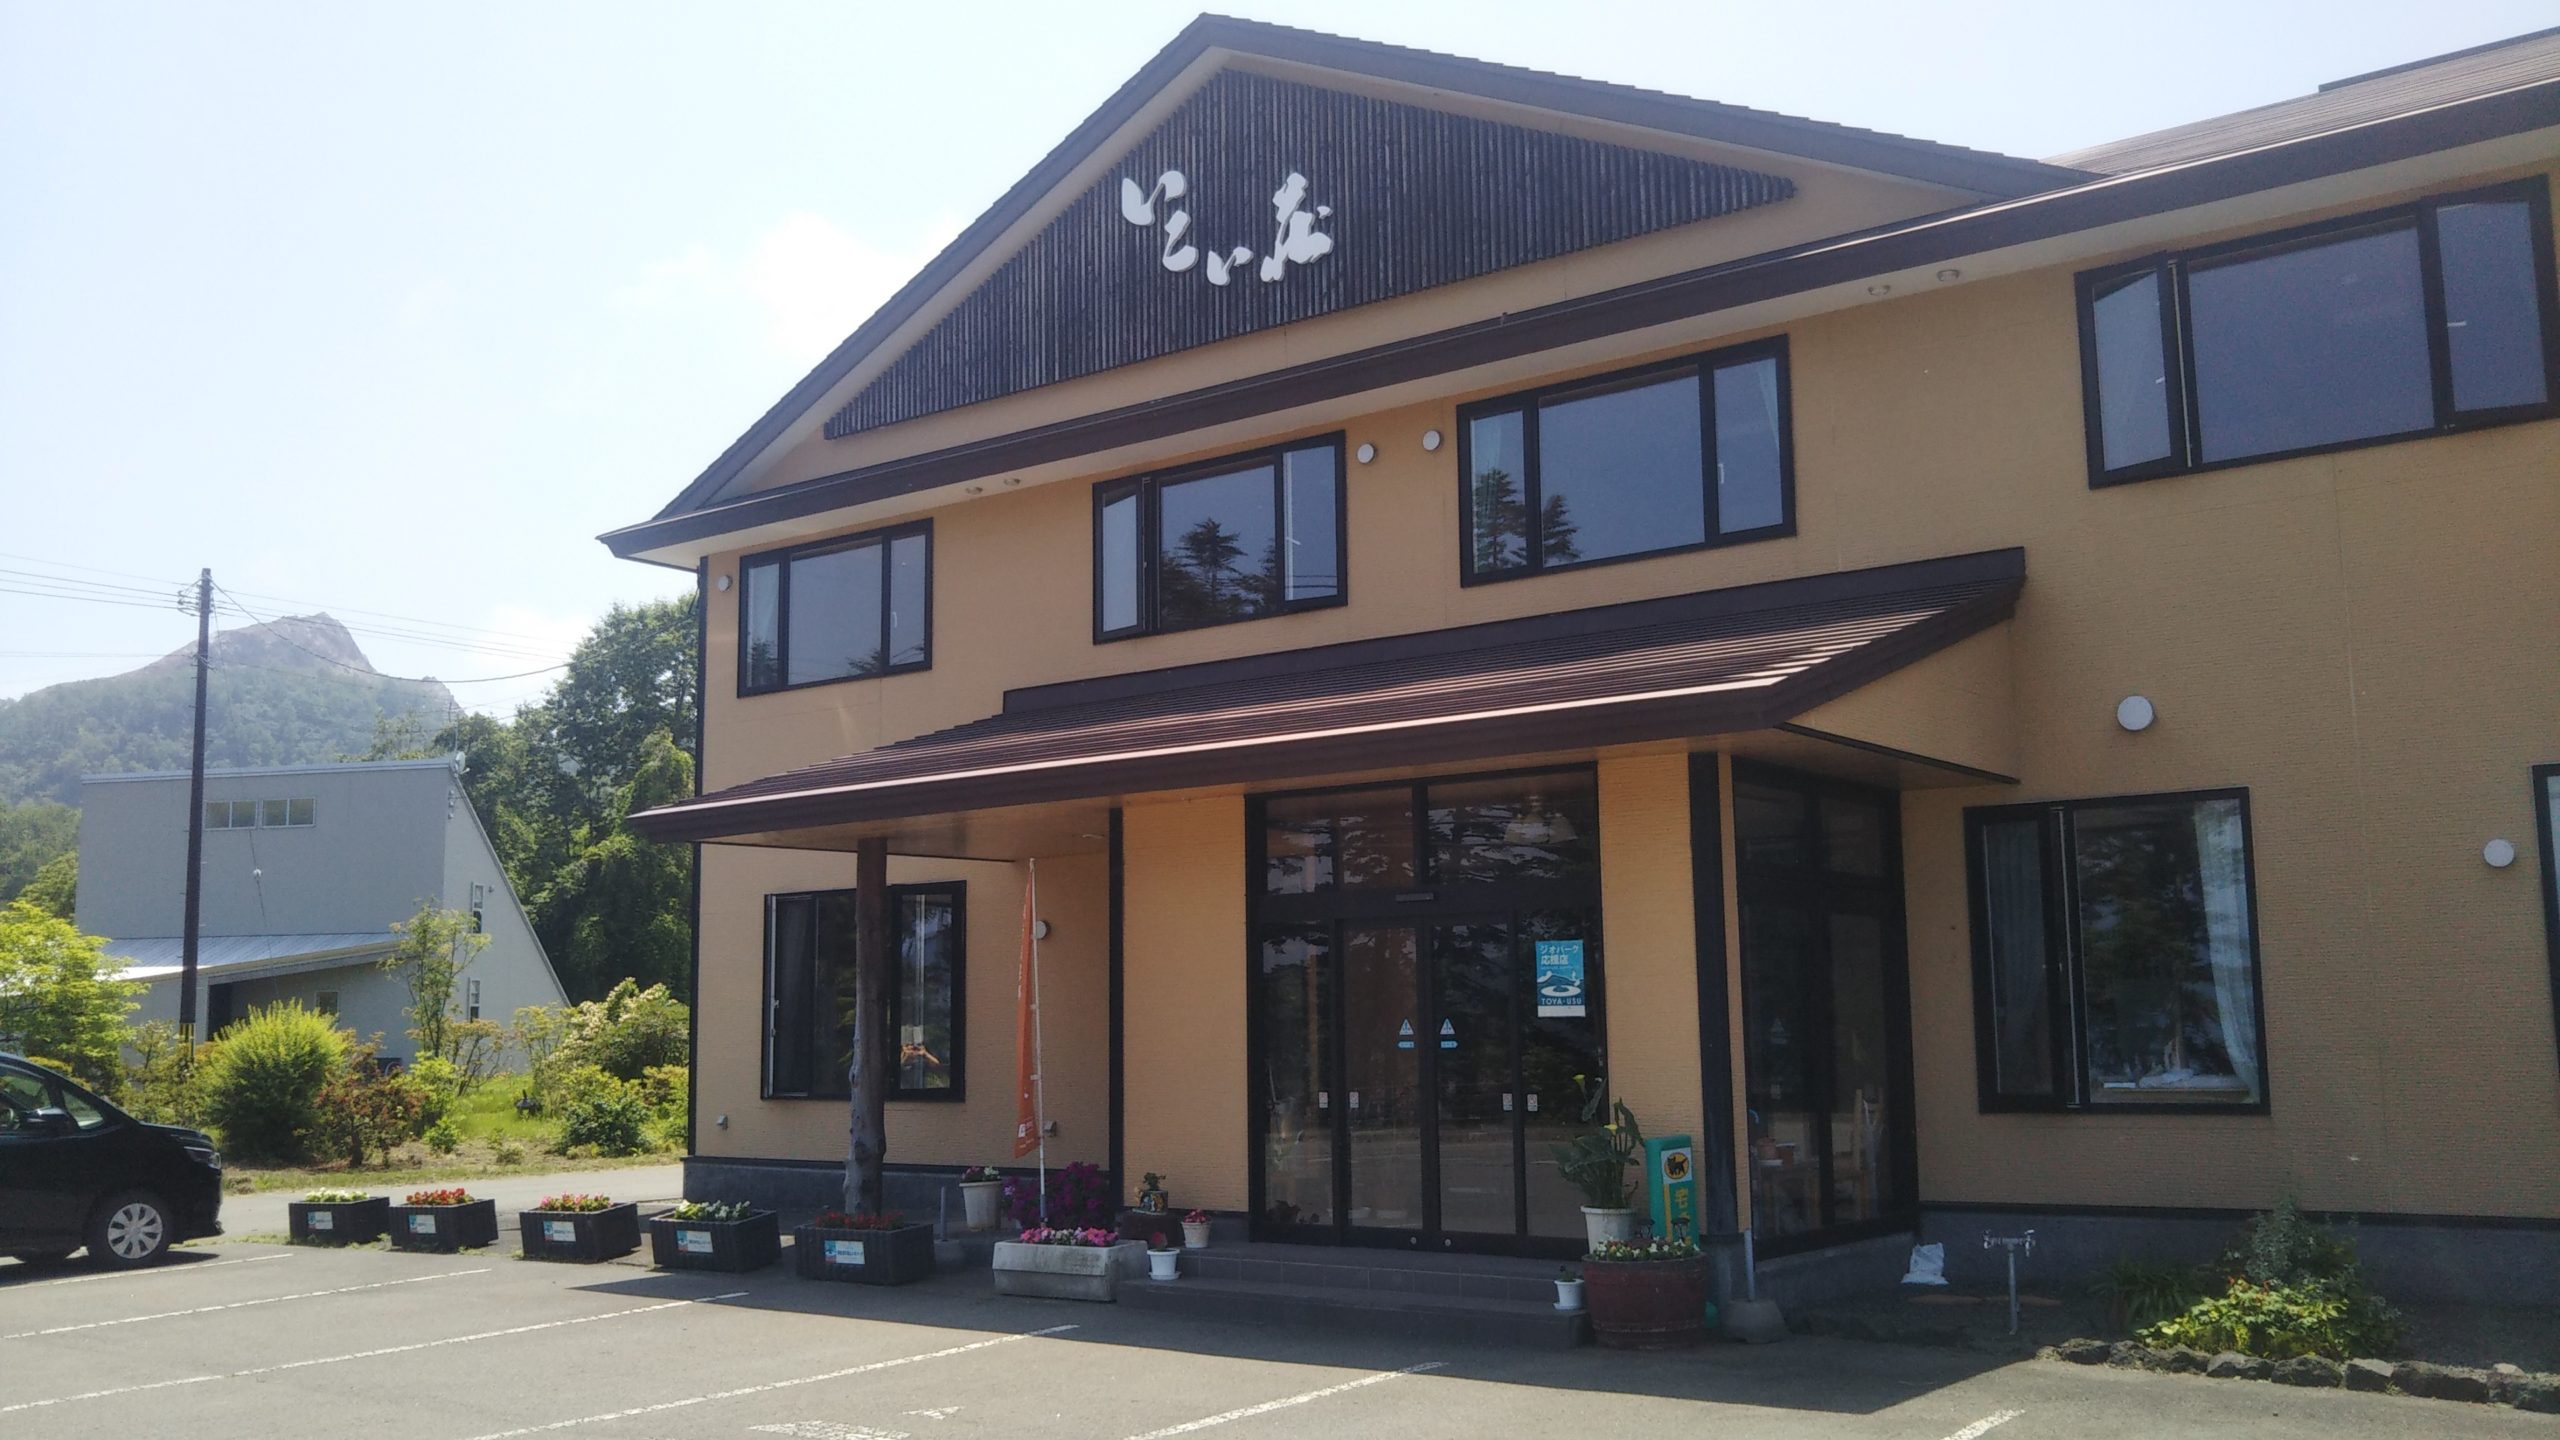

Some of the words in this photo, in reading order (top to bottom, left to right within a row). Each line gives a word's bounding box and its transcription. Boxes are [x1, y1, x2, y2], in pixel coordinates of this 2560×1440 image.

[1540, 945, 1579, 954] ジオパーク
